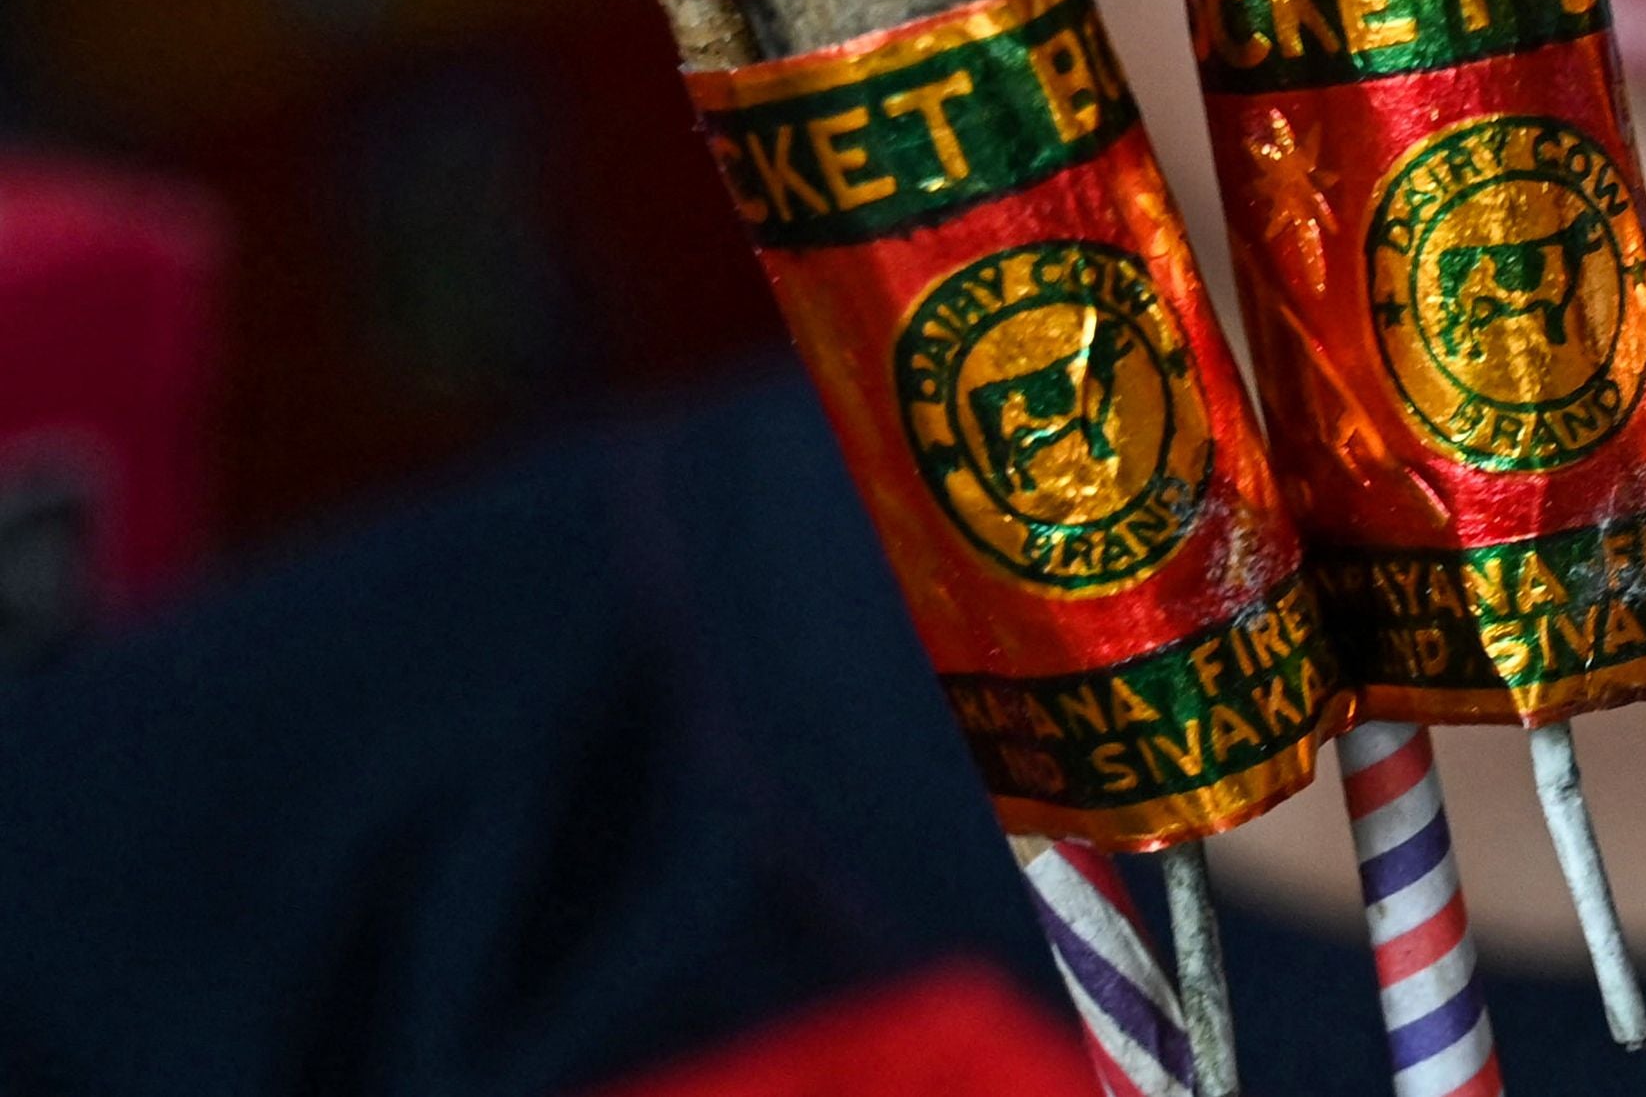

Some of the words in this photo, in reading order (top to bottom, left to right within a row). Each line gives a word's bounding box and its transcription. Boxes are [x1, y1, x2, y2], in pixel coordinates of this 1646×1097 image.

[1534, 124, 1628, 218] COW
[1449, 379, 1621, 458] BRAND
[1190, 582, 1312, 700] FIRE
